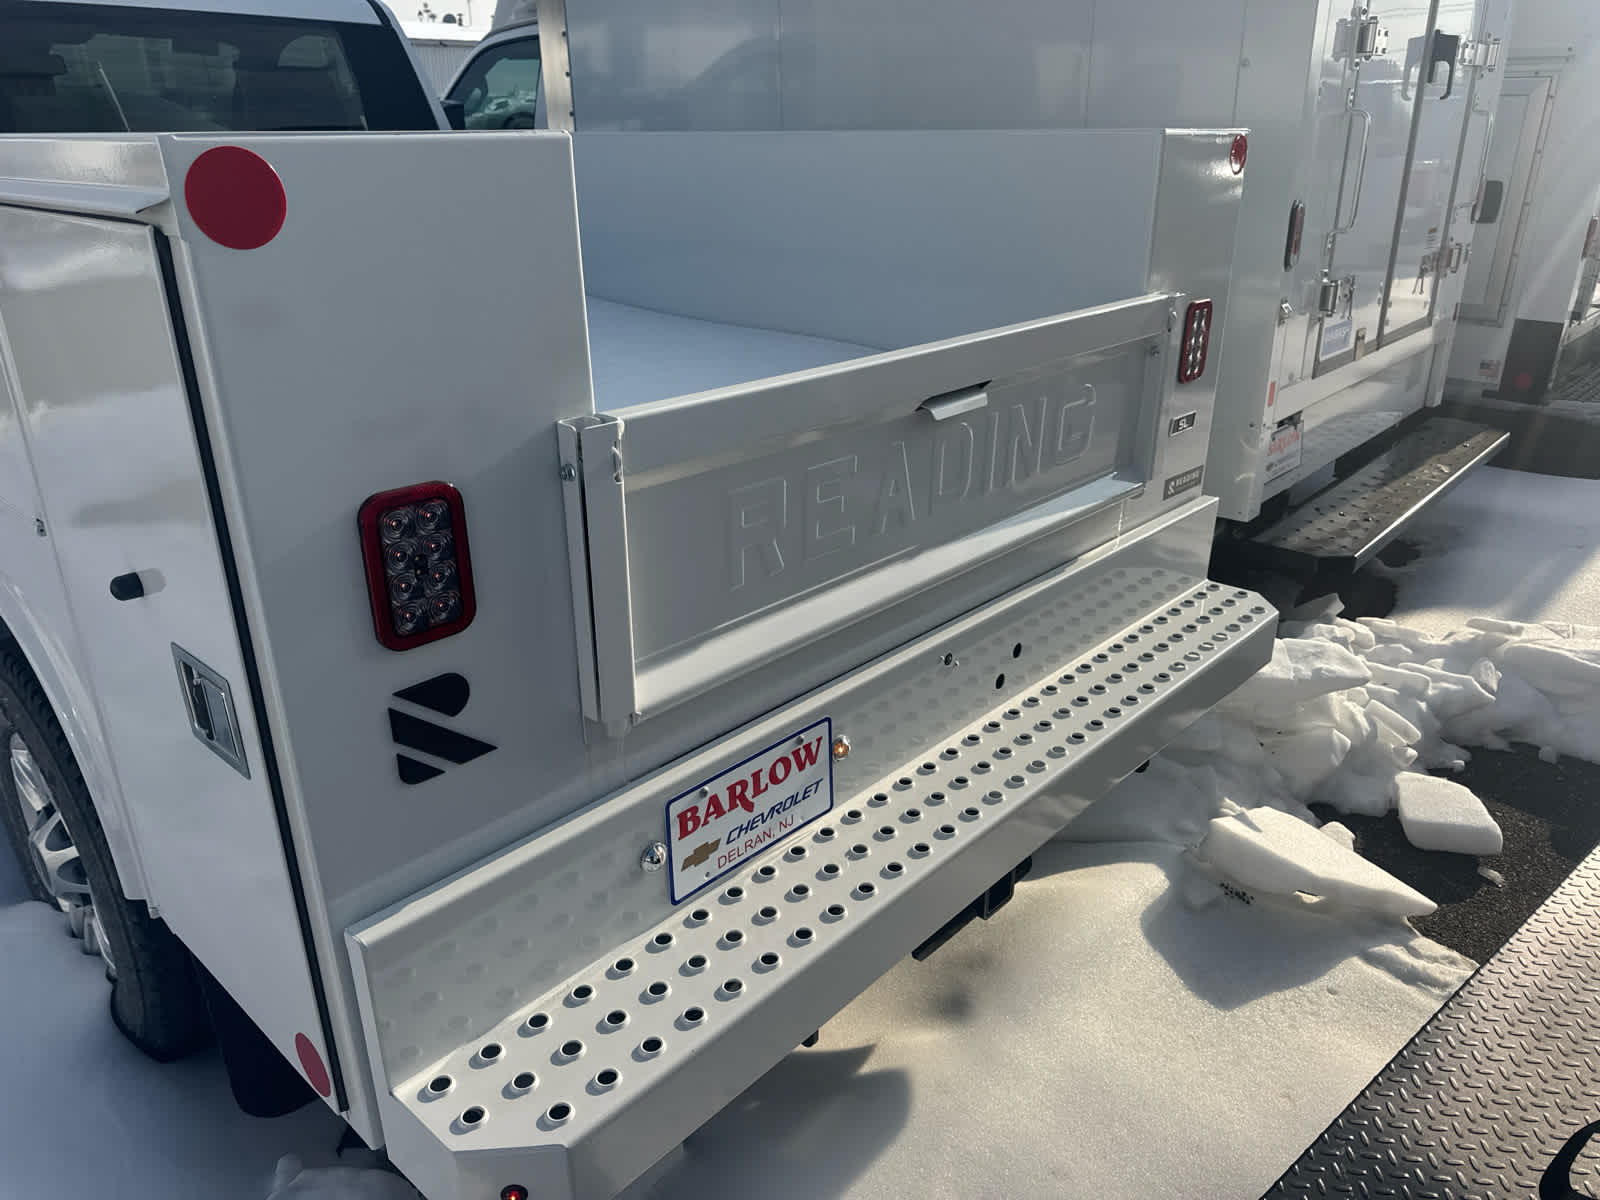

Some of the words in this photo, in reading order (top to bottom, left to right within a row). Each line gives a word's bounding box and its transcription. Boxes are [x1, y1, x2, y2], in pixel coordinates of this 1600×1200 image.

[727, 383, 1097, 592] READING
[677, 736, 823, 841] BARLOW
[726, 778, 824, 845] CHEVROLET
[717, 828, 776, 869] DELRAN,
[778, 815, 795, 832] NJ
